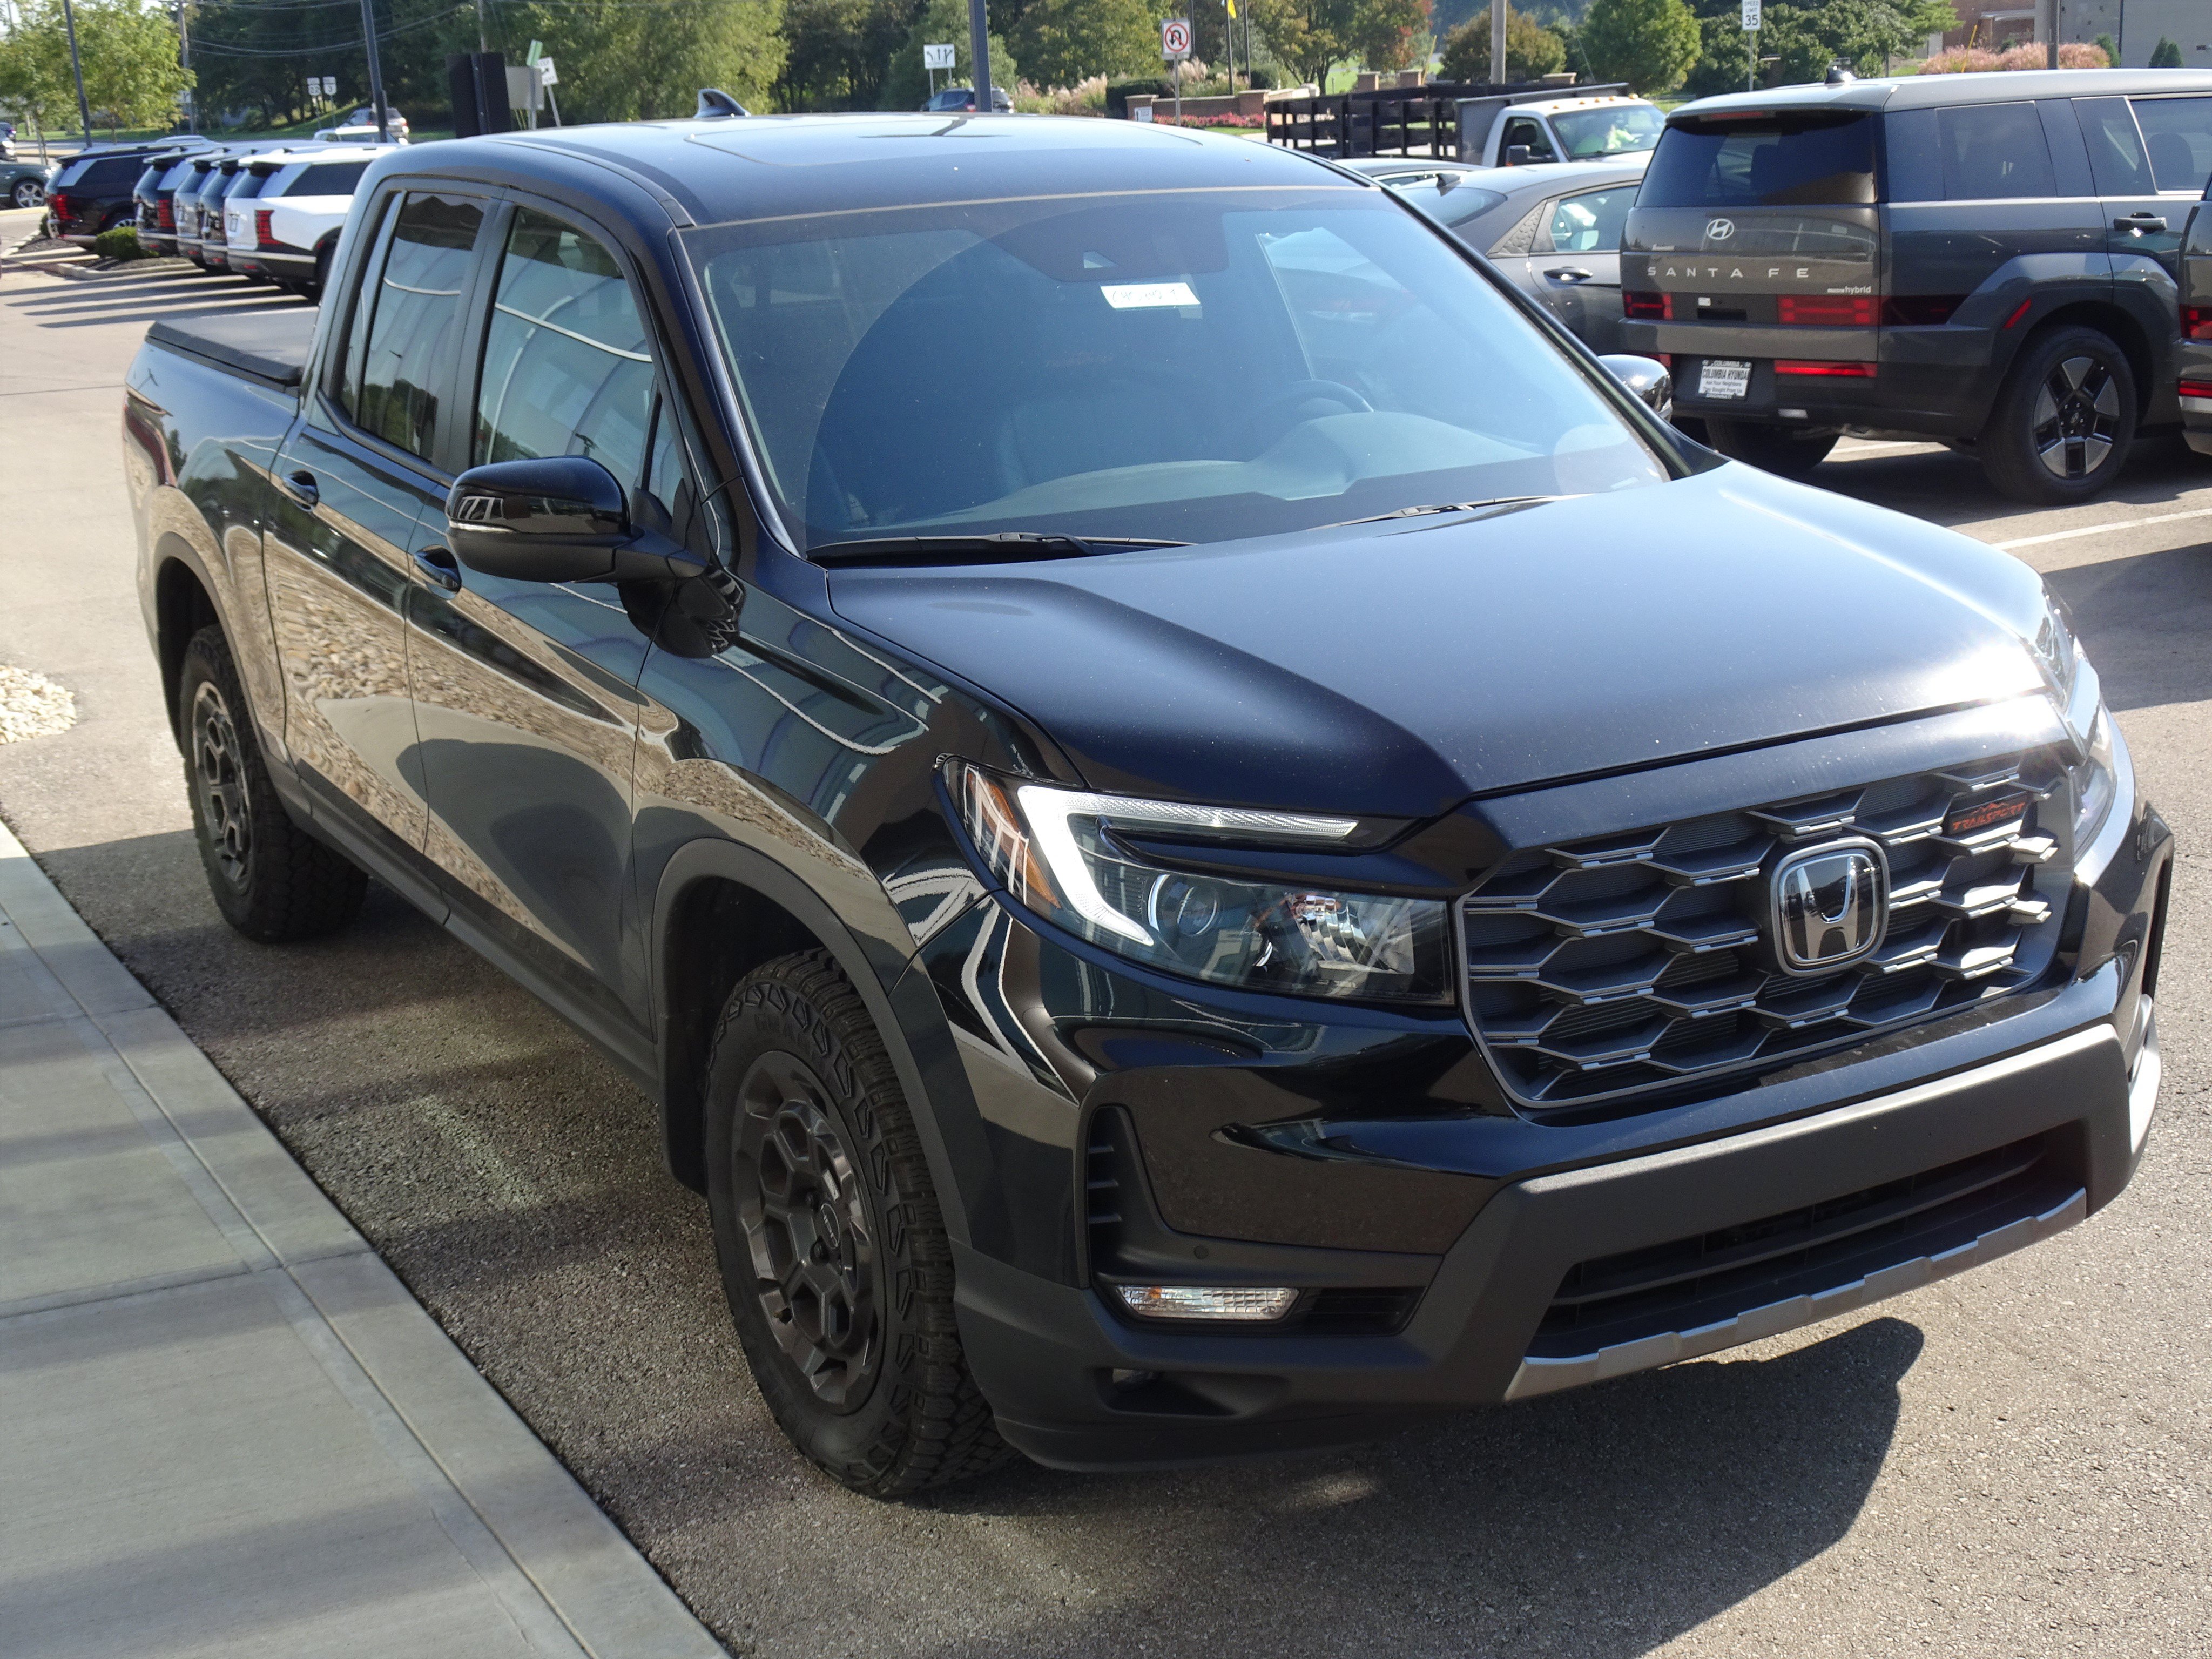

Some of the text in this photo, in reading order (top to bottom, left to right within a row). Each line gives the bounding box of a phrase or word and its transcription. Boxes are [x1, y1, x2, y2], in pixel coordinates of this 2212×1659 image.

[1745, 15, 1758, 26] 35
[1648, 267, 1809, 278] SANTA FE
[1845, 285, 1872, 295] hybrid
[1702, 368, 1727, 379] COLUMBIA
[1952, 802, 2026, 831] TRAILSPORT
